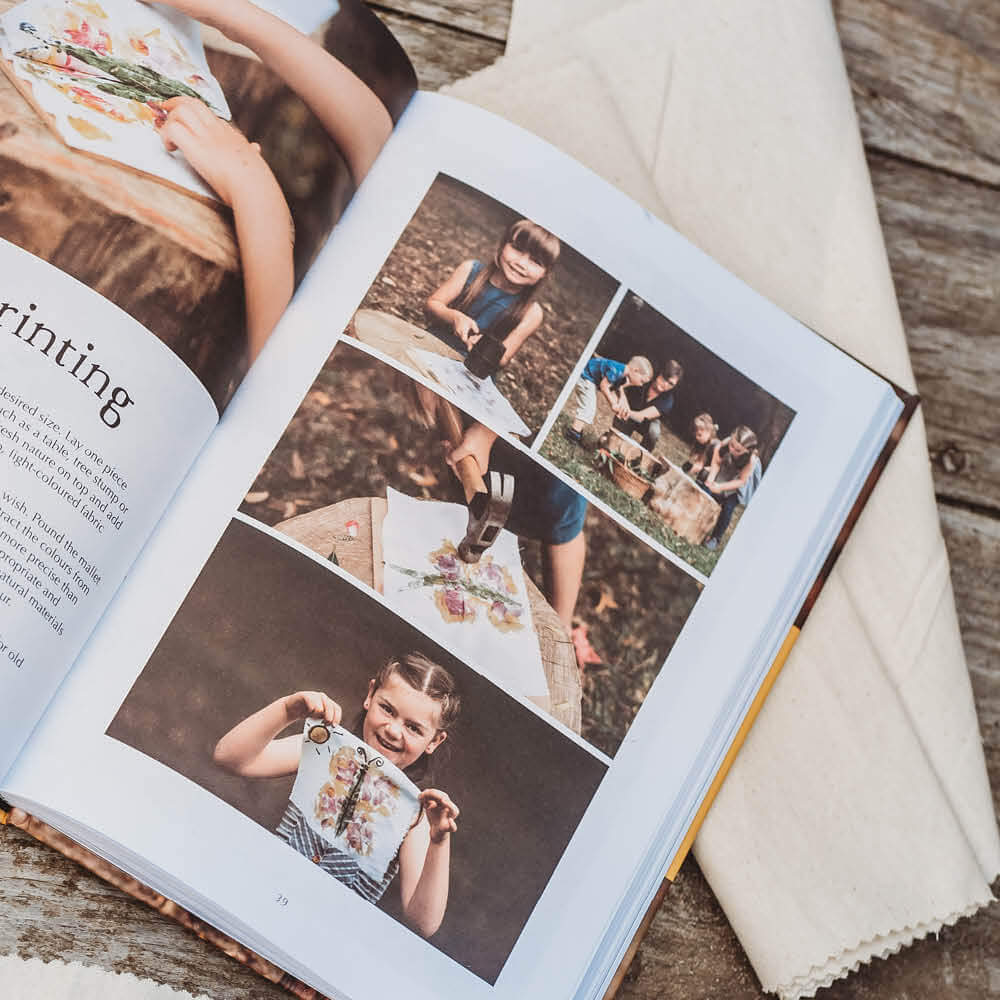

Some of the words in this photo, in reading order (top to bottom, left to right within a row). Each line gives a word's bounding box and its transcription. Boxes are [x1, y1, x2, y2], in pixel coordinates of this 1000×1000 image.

[18, 420, 31, 431] as
[42, 434, 69, 461] table,
[73, 457, 92, 477] tree
[92, 475, 119, 504] stump
[118, 502, 129, 514] or
[21, 441, 56, 468] nature
[57, 466, 71, 481] on
[72, 477, 89, 496] top
[89, 494, 109, 513] and
[106, 511, 124, 530] add
[38, 414, 61, 438] size.
[65, 430, 84, 451] Lay
[84, 448, 103, 466] one
[102, 464, 127, 490] piece
[8, 449, 82, 508] light-coloured
[80, 504, 104, 534] fabric
[0, 531, 27, 555] more
[26, 552, 61, 586] precise
[60, 582, 78, 605] than
[2, 492, 28, 517] wish.
[32, 512, 65, 544] Pound
[63, 540, 78, 559] the
[78, 556, 101, 585] mallet
[21, 526, 39, 544] the
[39, 542, 73, 575] colours
[72, 570, 90, 596] from
[28, 596, 64, 636] materials
[42, 587, 62, 607] and
[7, 651, 25, 668] old
[276, 892, 289, 906] 39
